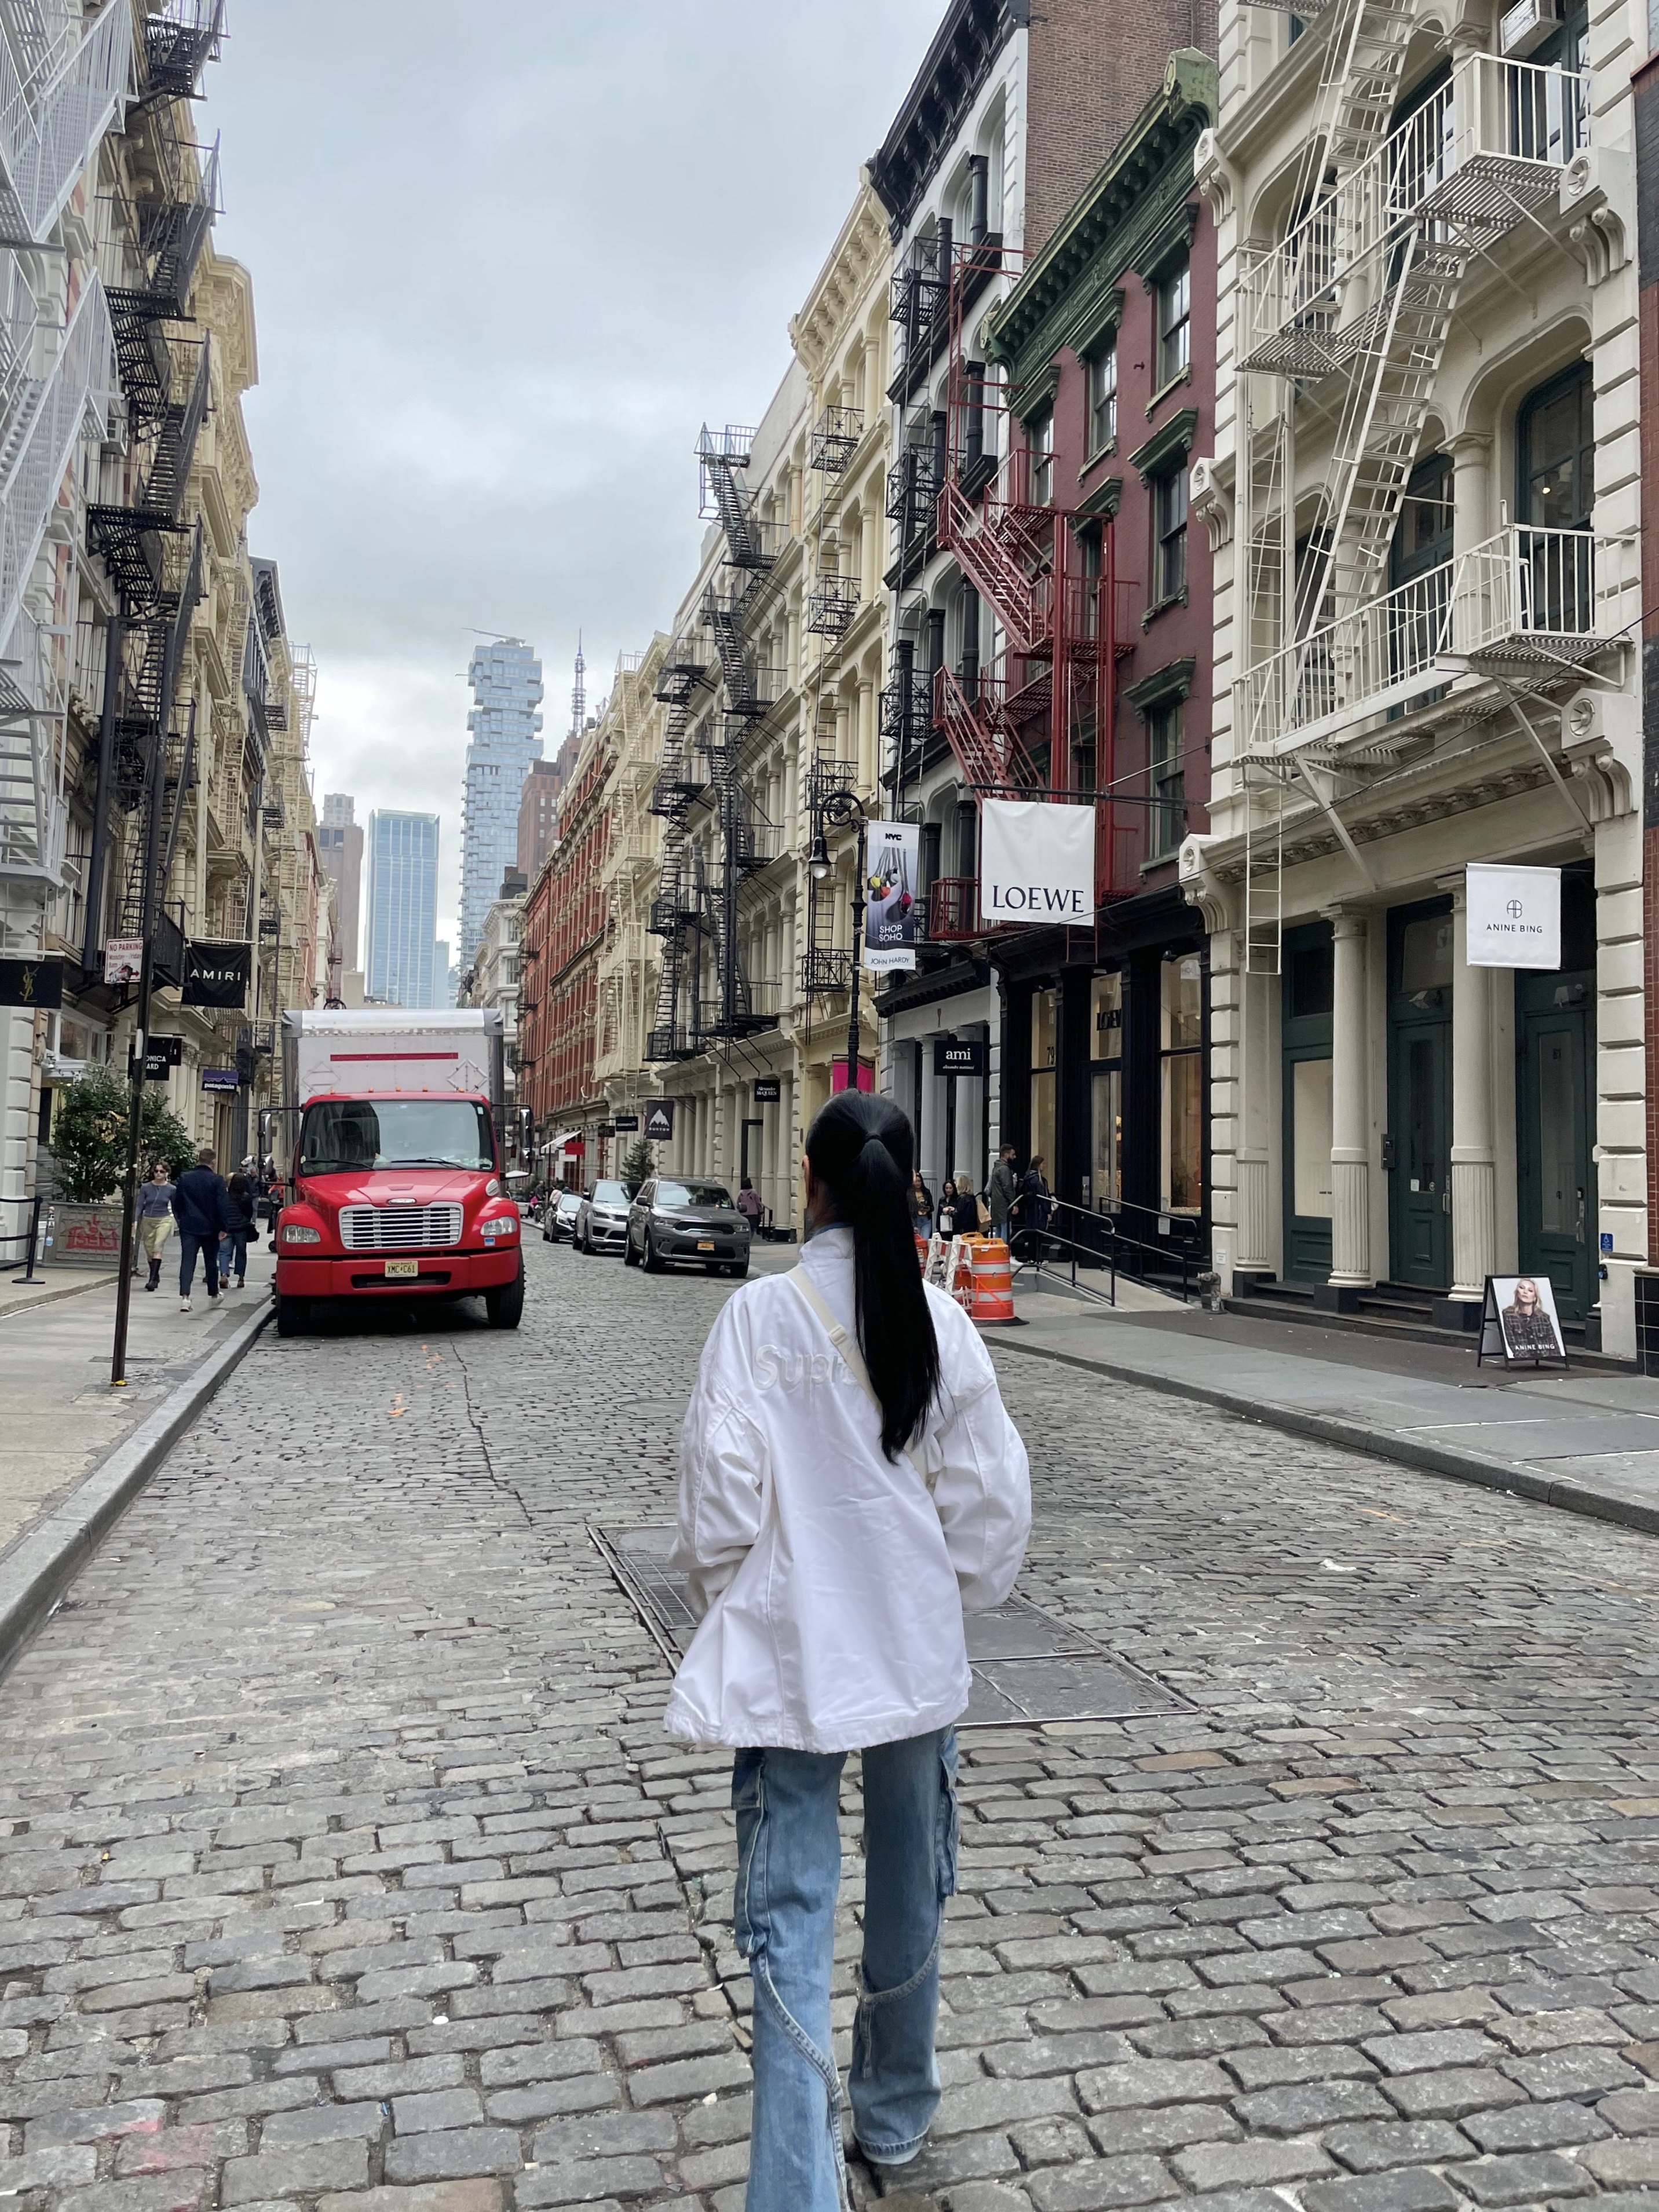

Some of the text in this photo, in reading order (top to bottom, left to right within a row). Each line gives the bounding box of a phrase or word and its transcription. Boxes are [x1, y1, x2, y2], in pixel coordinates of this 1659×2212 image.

[993, 885, 1084, 912] LOEWE
[879, 924, 902, 934] SHOP
[1486, 924, 1543, 933] ANINE BING
[879, 933, 903, 942] SOHO
[119, 942, 142, 950] PARKING
[190, 968, 241, 981] AMIRI
[945, 1048, 971, 1060] ami
